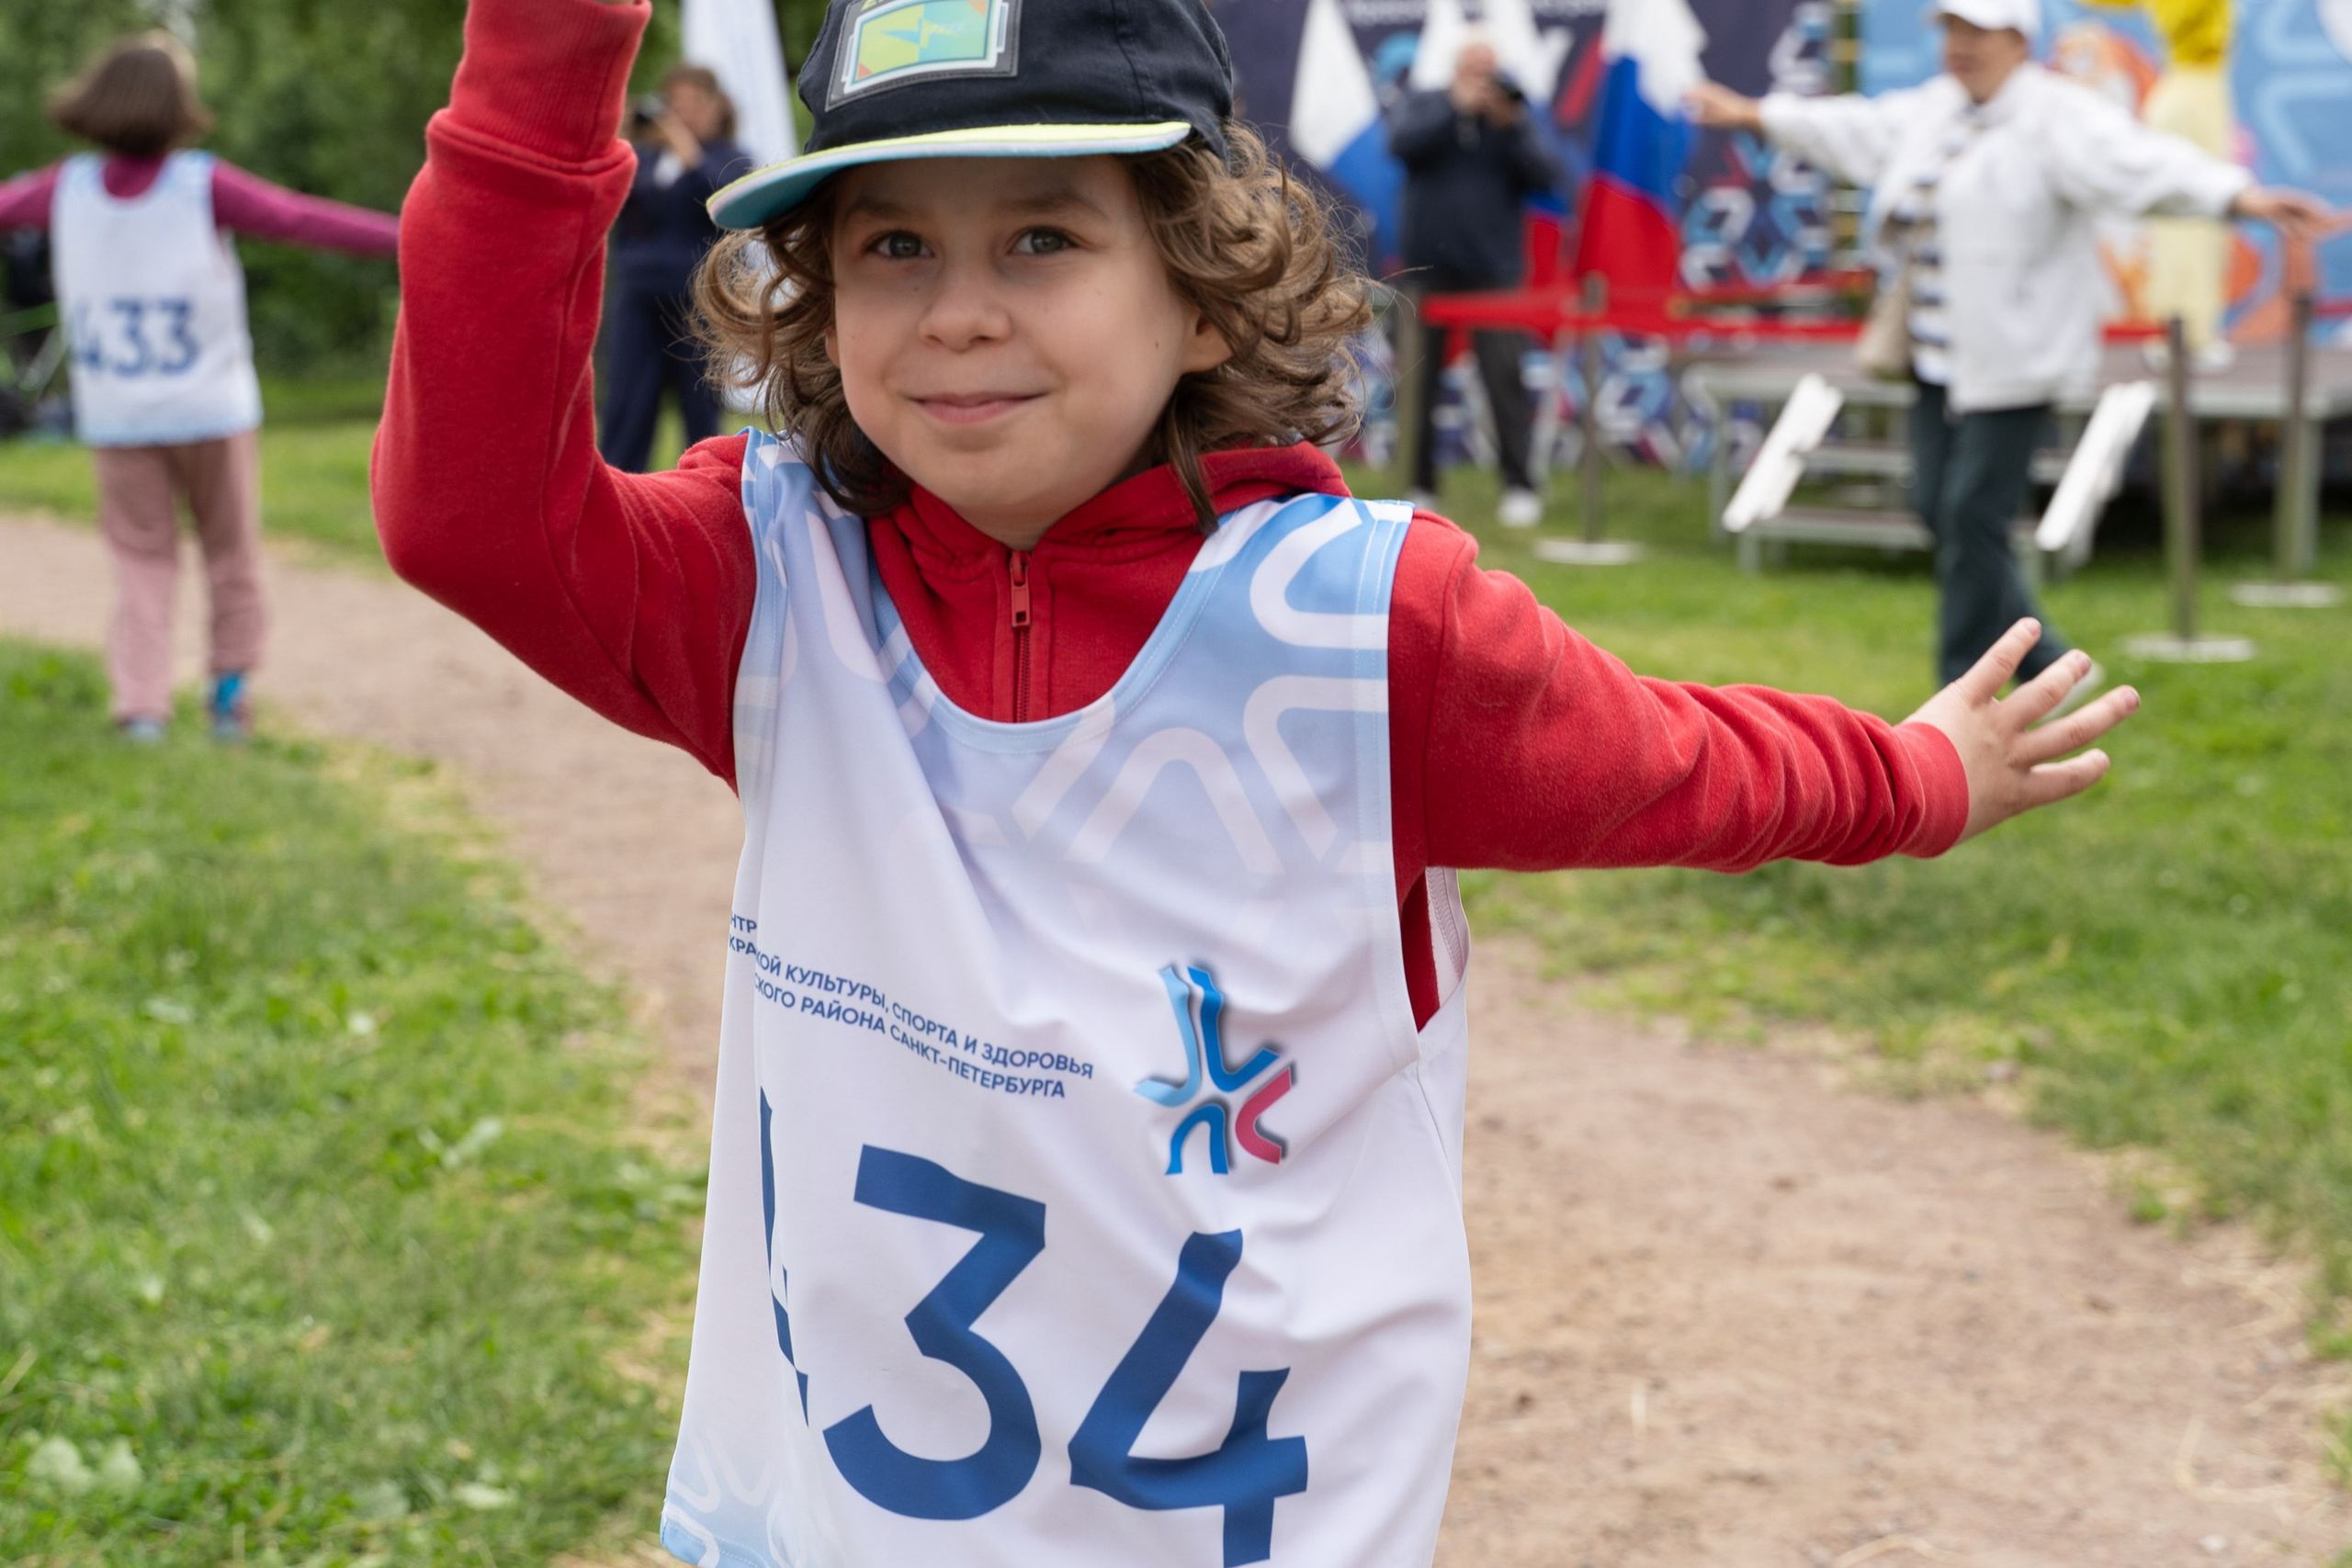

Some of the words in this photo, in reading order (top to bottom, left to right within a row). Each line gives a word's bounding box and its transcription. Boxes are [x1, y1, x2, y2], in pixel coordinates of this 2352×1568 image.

[730, 913, 758, 933] НТР
[786, 964, 888, 1013] КУЛЬТУРЫ,
[892, 1002, 958, 1048] СПОРТА
[963, 1035, 978, 1055] И
[981, 1043, 1093, 1079] ЗДОРОВЬЯ
[801, 996, 886, 1034] РАЙОНА
[890, 1024, 1066, 1099] САНКТ-ПЕТЕРБУРГА
[760, 1087, 1309, 1567] 34
